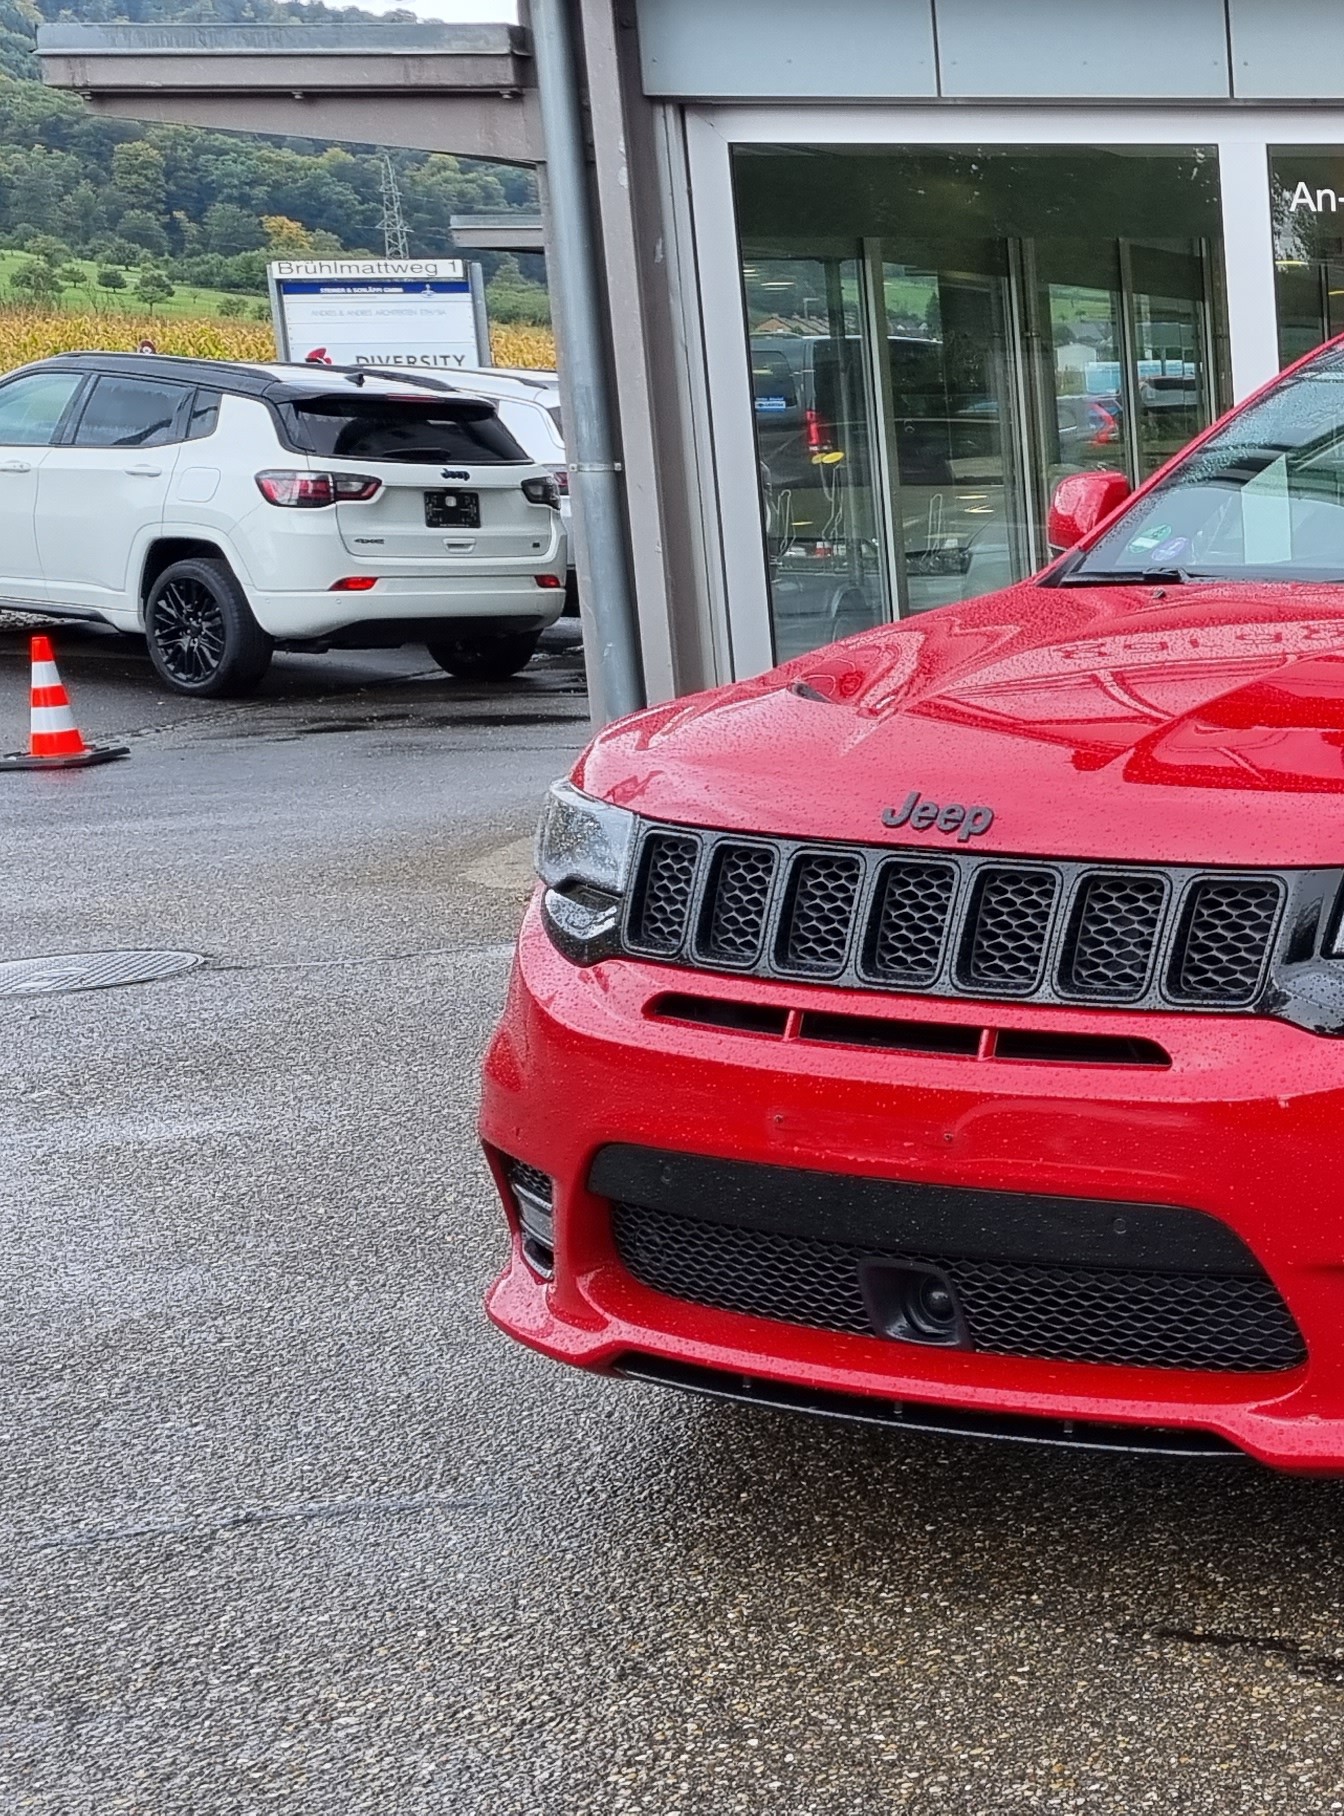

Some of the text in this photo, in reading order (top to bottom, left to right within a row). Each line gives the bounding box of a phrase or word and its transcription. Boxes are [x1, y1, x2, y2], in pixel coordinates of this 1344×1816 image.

[278, 260, 457, 276] Brühlmattweg 1
[881, 791, 994, 843] Jeep
